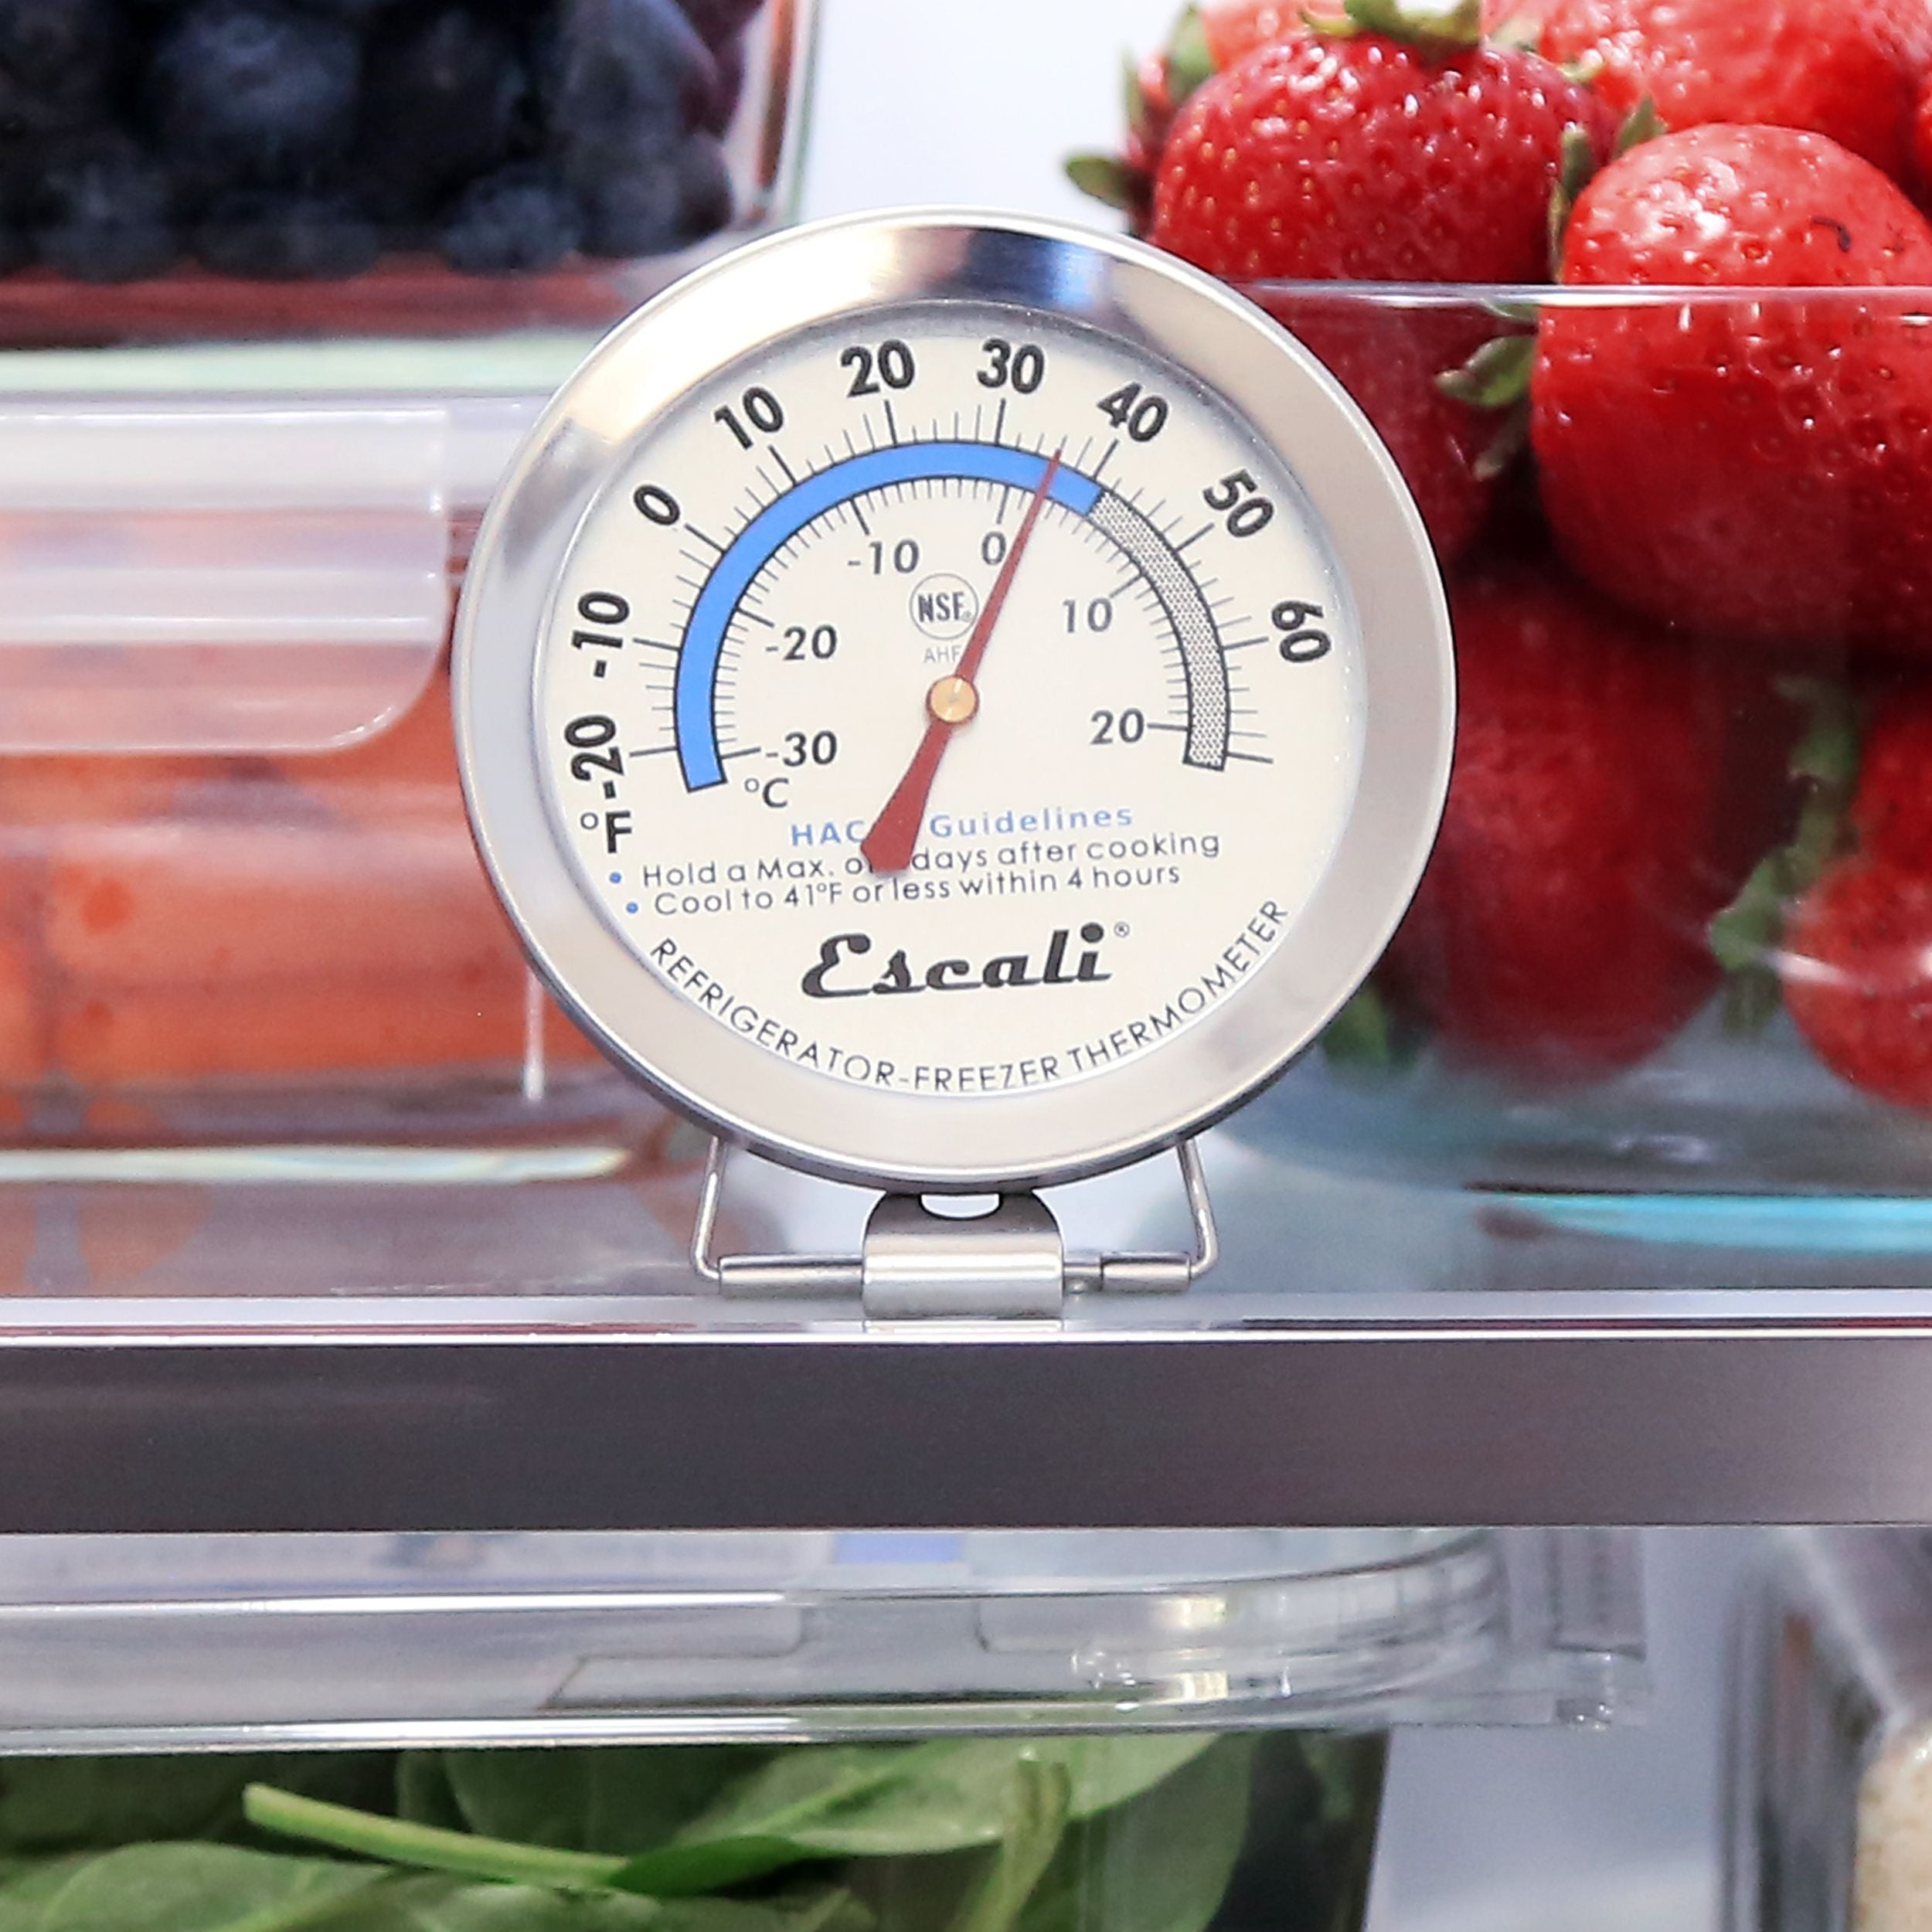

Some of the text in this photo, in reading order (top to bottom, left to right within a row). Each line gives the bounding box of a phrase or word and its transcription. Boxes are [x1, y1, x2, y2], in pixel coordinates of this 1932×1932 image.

[840, 338, 915, 398] 20
[975, 337, 1046, 395] 30
[714, 387, 784, 450] 10
[1097, 383, 1168, 442] 40
[633, 485, 680, 526] 0
[1202, 468, 1274, 538] 50
[847, 539, 920, 577] -10
[980, 530, 1006, 566] 0
[571, 591, 630, 678] -10
[1062, 597, 1113, 634] 10
[1270, 600, 1332, 665] 60
[765, 624, 838, 662] -20
[765, 730, 838, 767] -30
[1090, 708, 1145, 746] 20
[563, 714, 624, 800] -20
[743, 776, 790, 809] °C
[580, 810, 633, 854] °F
[791, 806, 1133, 846] HAC Guidelines
[643, 860, 716, 888] Hold
[727, 864, 747, 883] a
[757, 856, 835, 879] Max.
[911, 847, 988, 875] days
[998, 840, 1077, 866] after
[1086, 832, 1219, 858] cooking
[654, 865, 1180, 917] Cool to 41°F or less within 4 hours
[650, 900, 1287, 1093] REFRIGERATOR-FREEZER THERMOMETER
